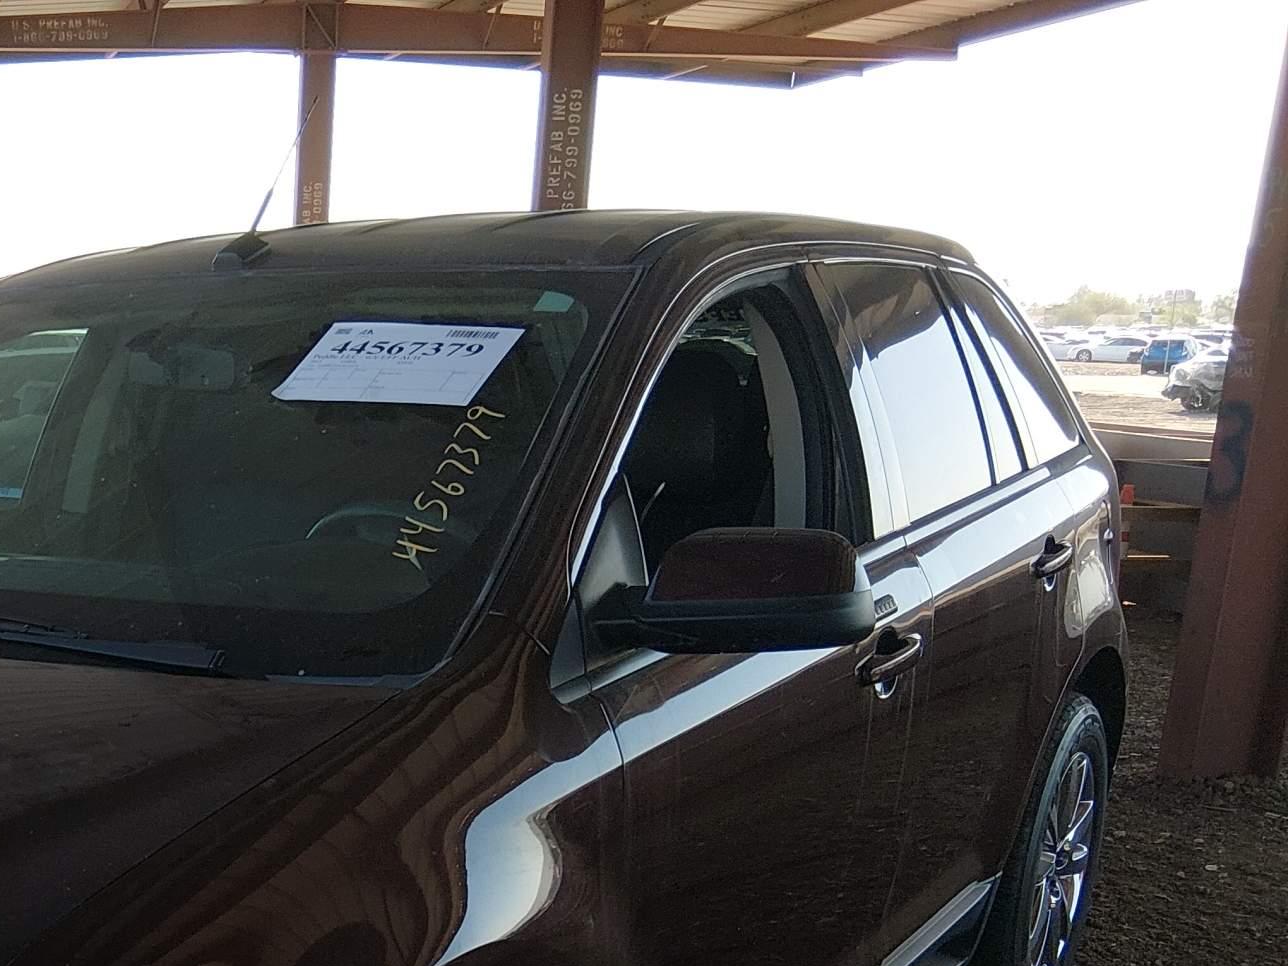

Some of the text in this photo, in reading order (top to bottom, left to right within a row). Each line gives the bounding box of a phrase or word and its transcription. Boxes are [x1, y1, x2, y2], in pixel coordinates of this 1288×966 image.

[546, 87, 568, 199] PREFAB INC.
[330, 340, 484, 357] 44567379
[392, 406, 506, 559] 44567379
